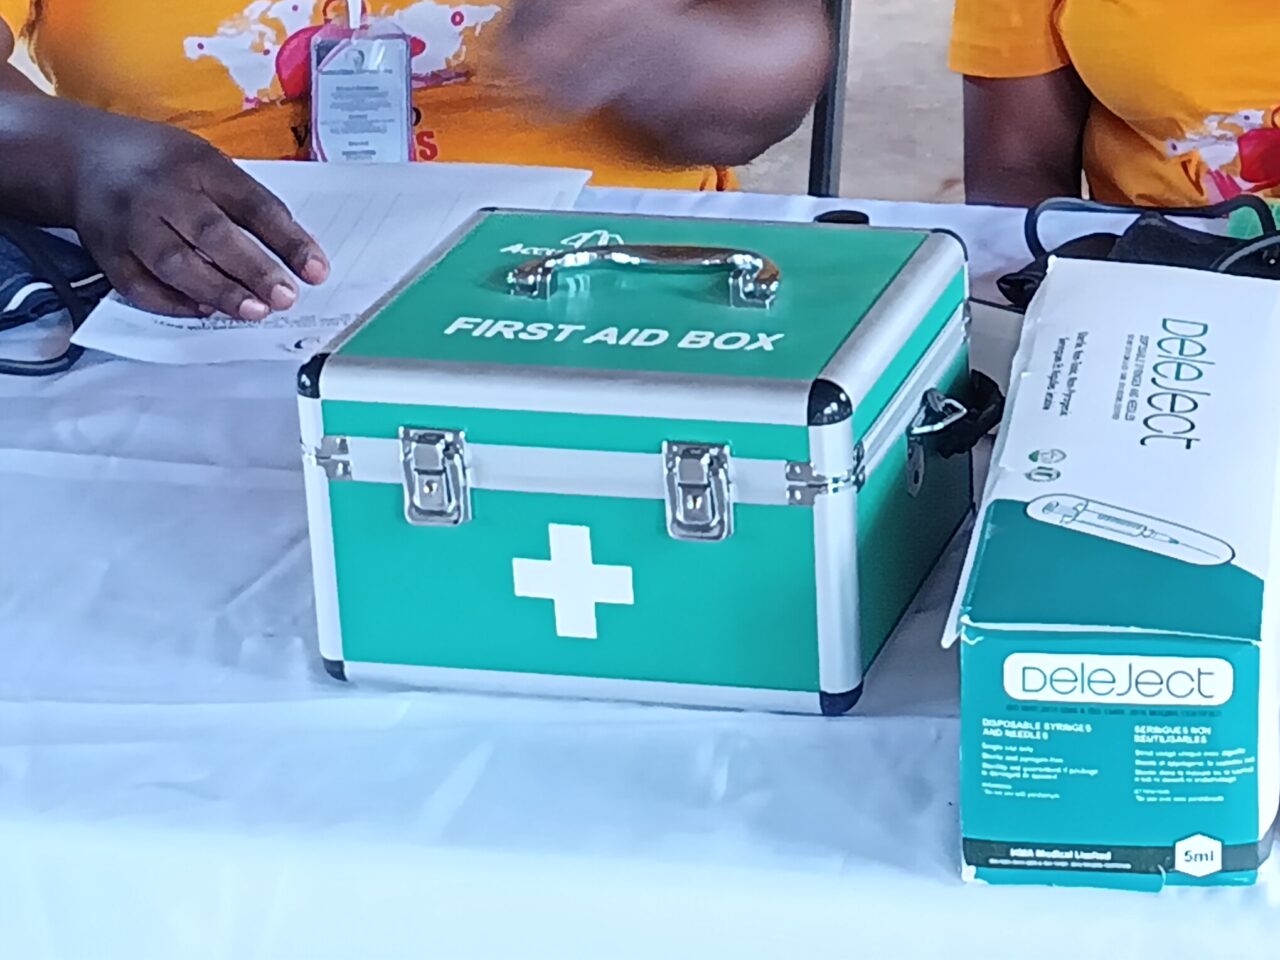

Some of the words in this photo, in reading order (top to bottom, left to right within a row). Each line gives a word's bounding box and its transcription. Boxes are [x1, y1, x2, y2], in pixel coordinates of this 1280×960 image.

[444, 316, 586, 342] FIRST
[583, 327, 669, 346] AID
[677, 330, 785, 351] BOX
[1184, 850, 1214, 863] 5ml
